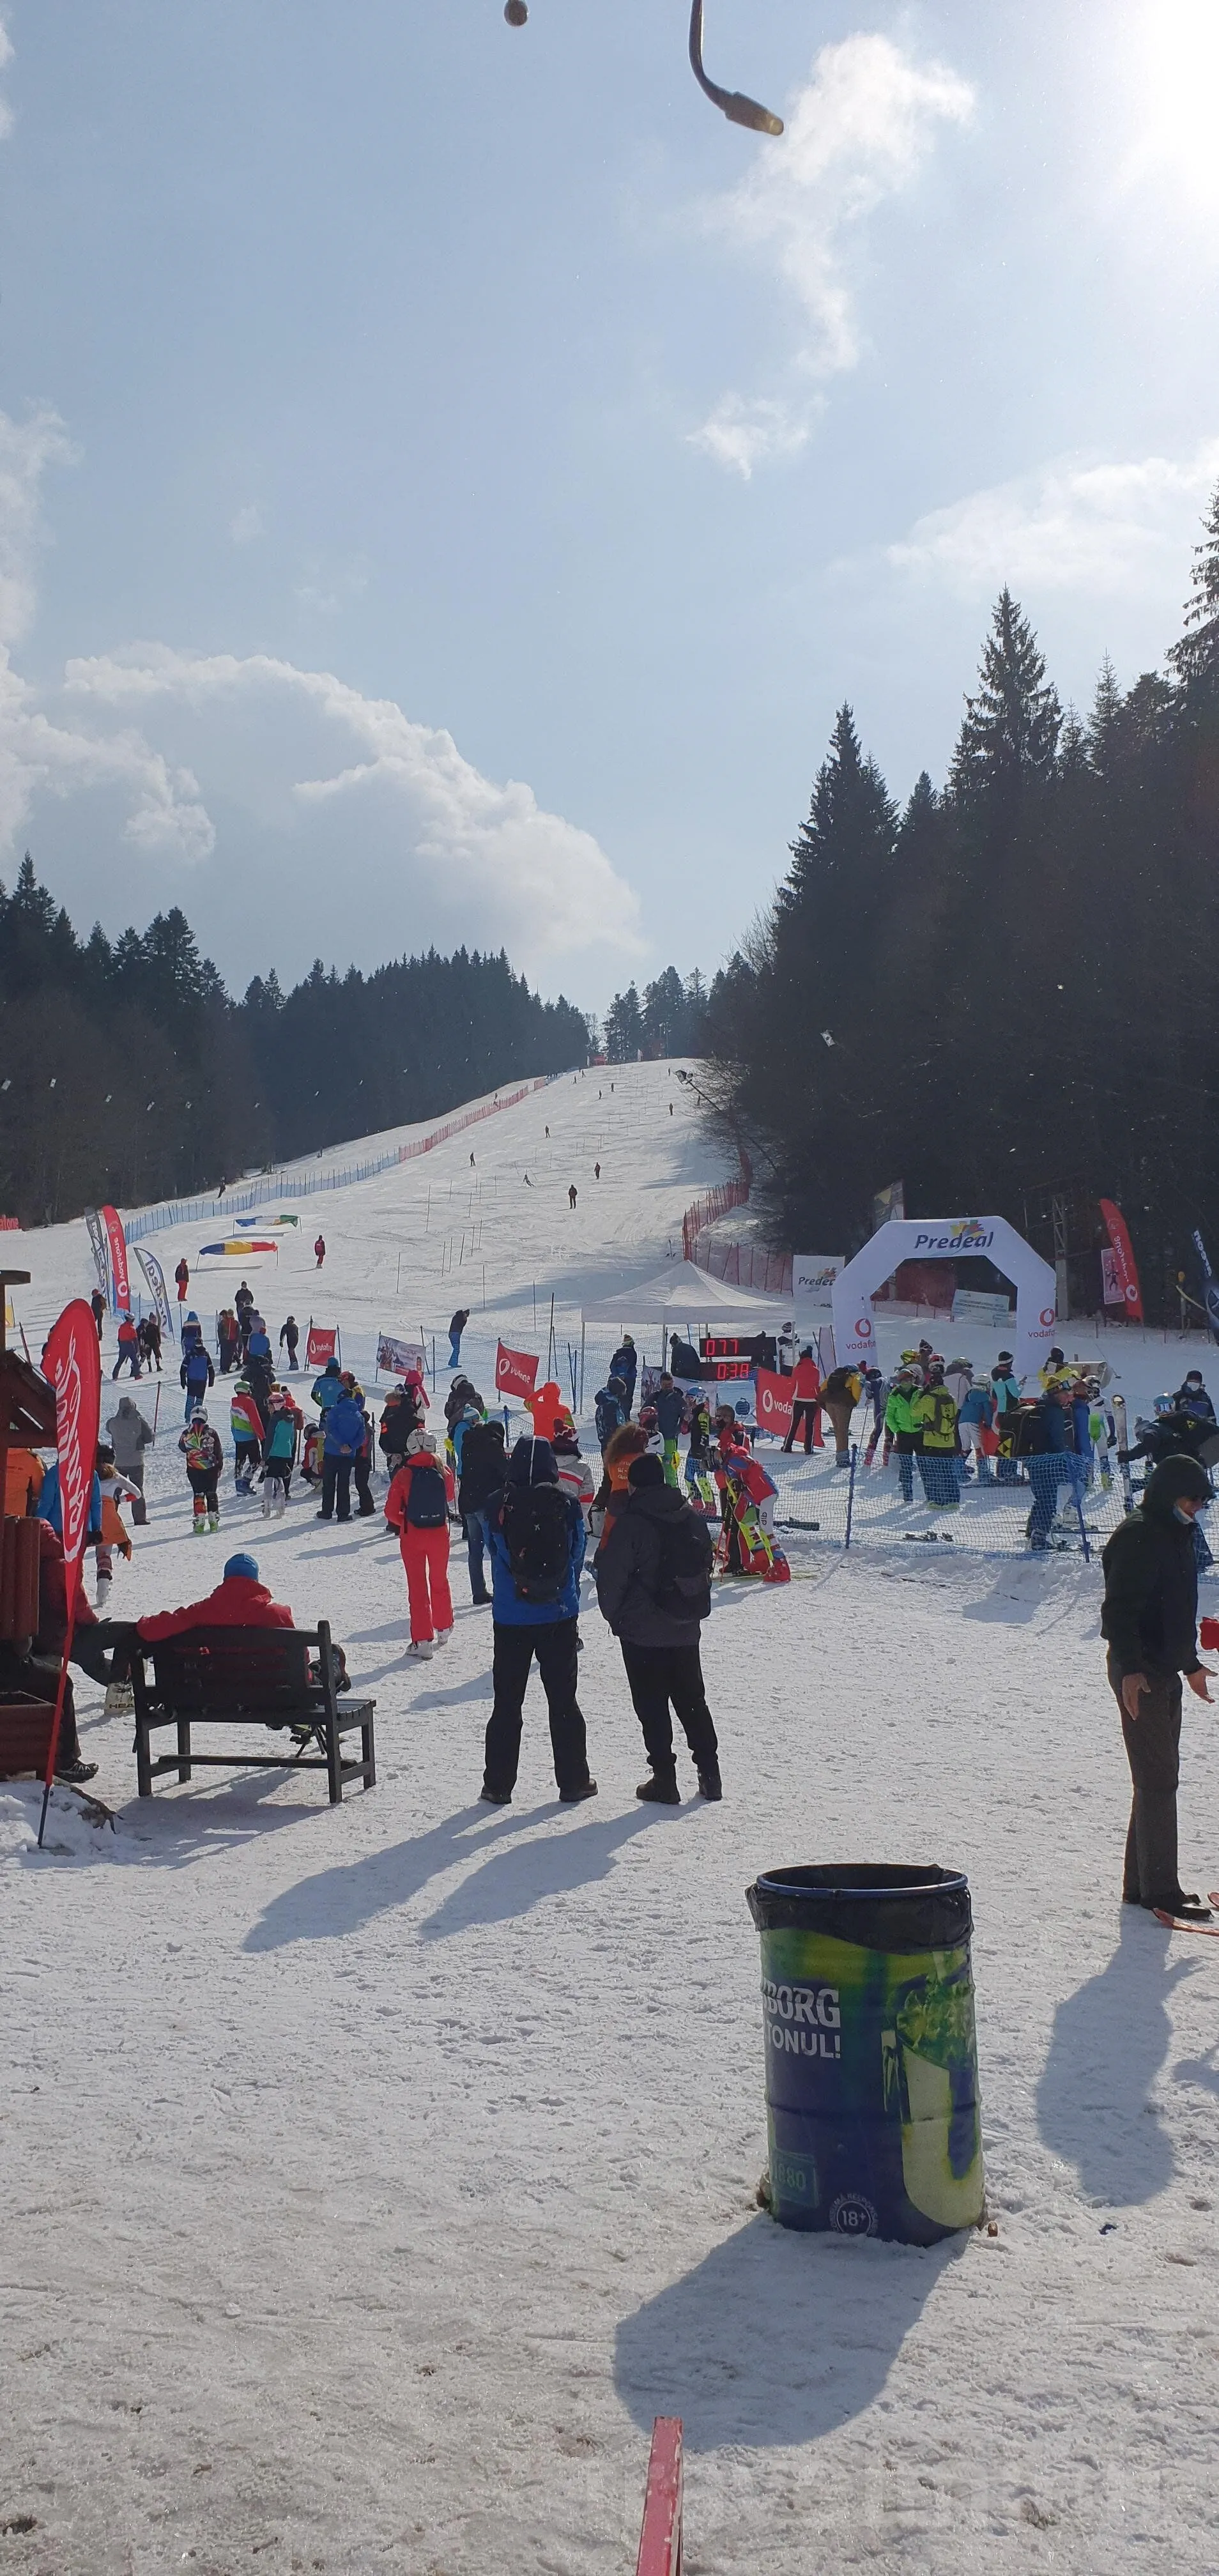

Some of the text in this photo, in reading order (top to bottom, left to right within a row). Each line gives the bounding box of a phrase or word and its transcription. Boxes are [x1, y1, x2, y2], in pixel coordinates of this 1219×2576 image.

[914, 1230, 994, 1250] Predeal
[706, 1339, 739, 1356] 077
[841, 2210, 867, 2227] 18+
